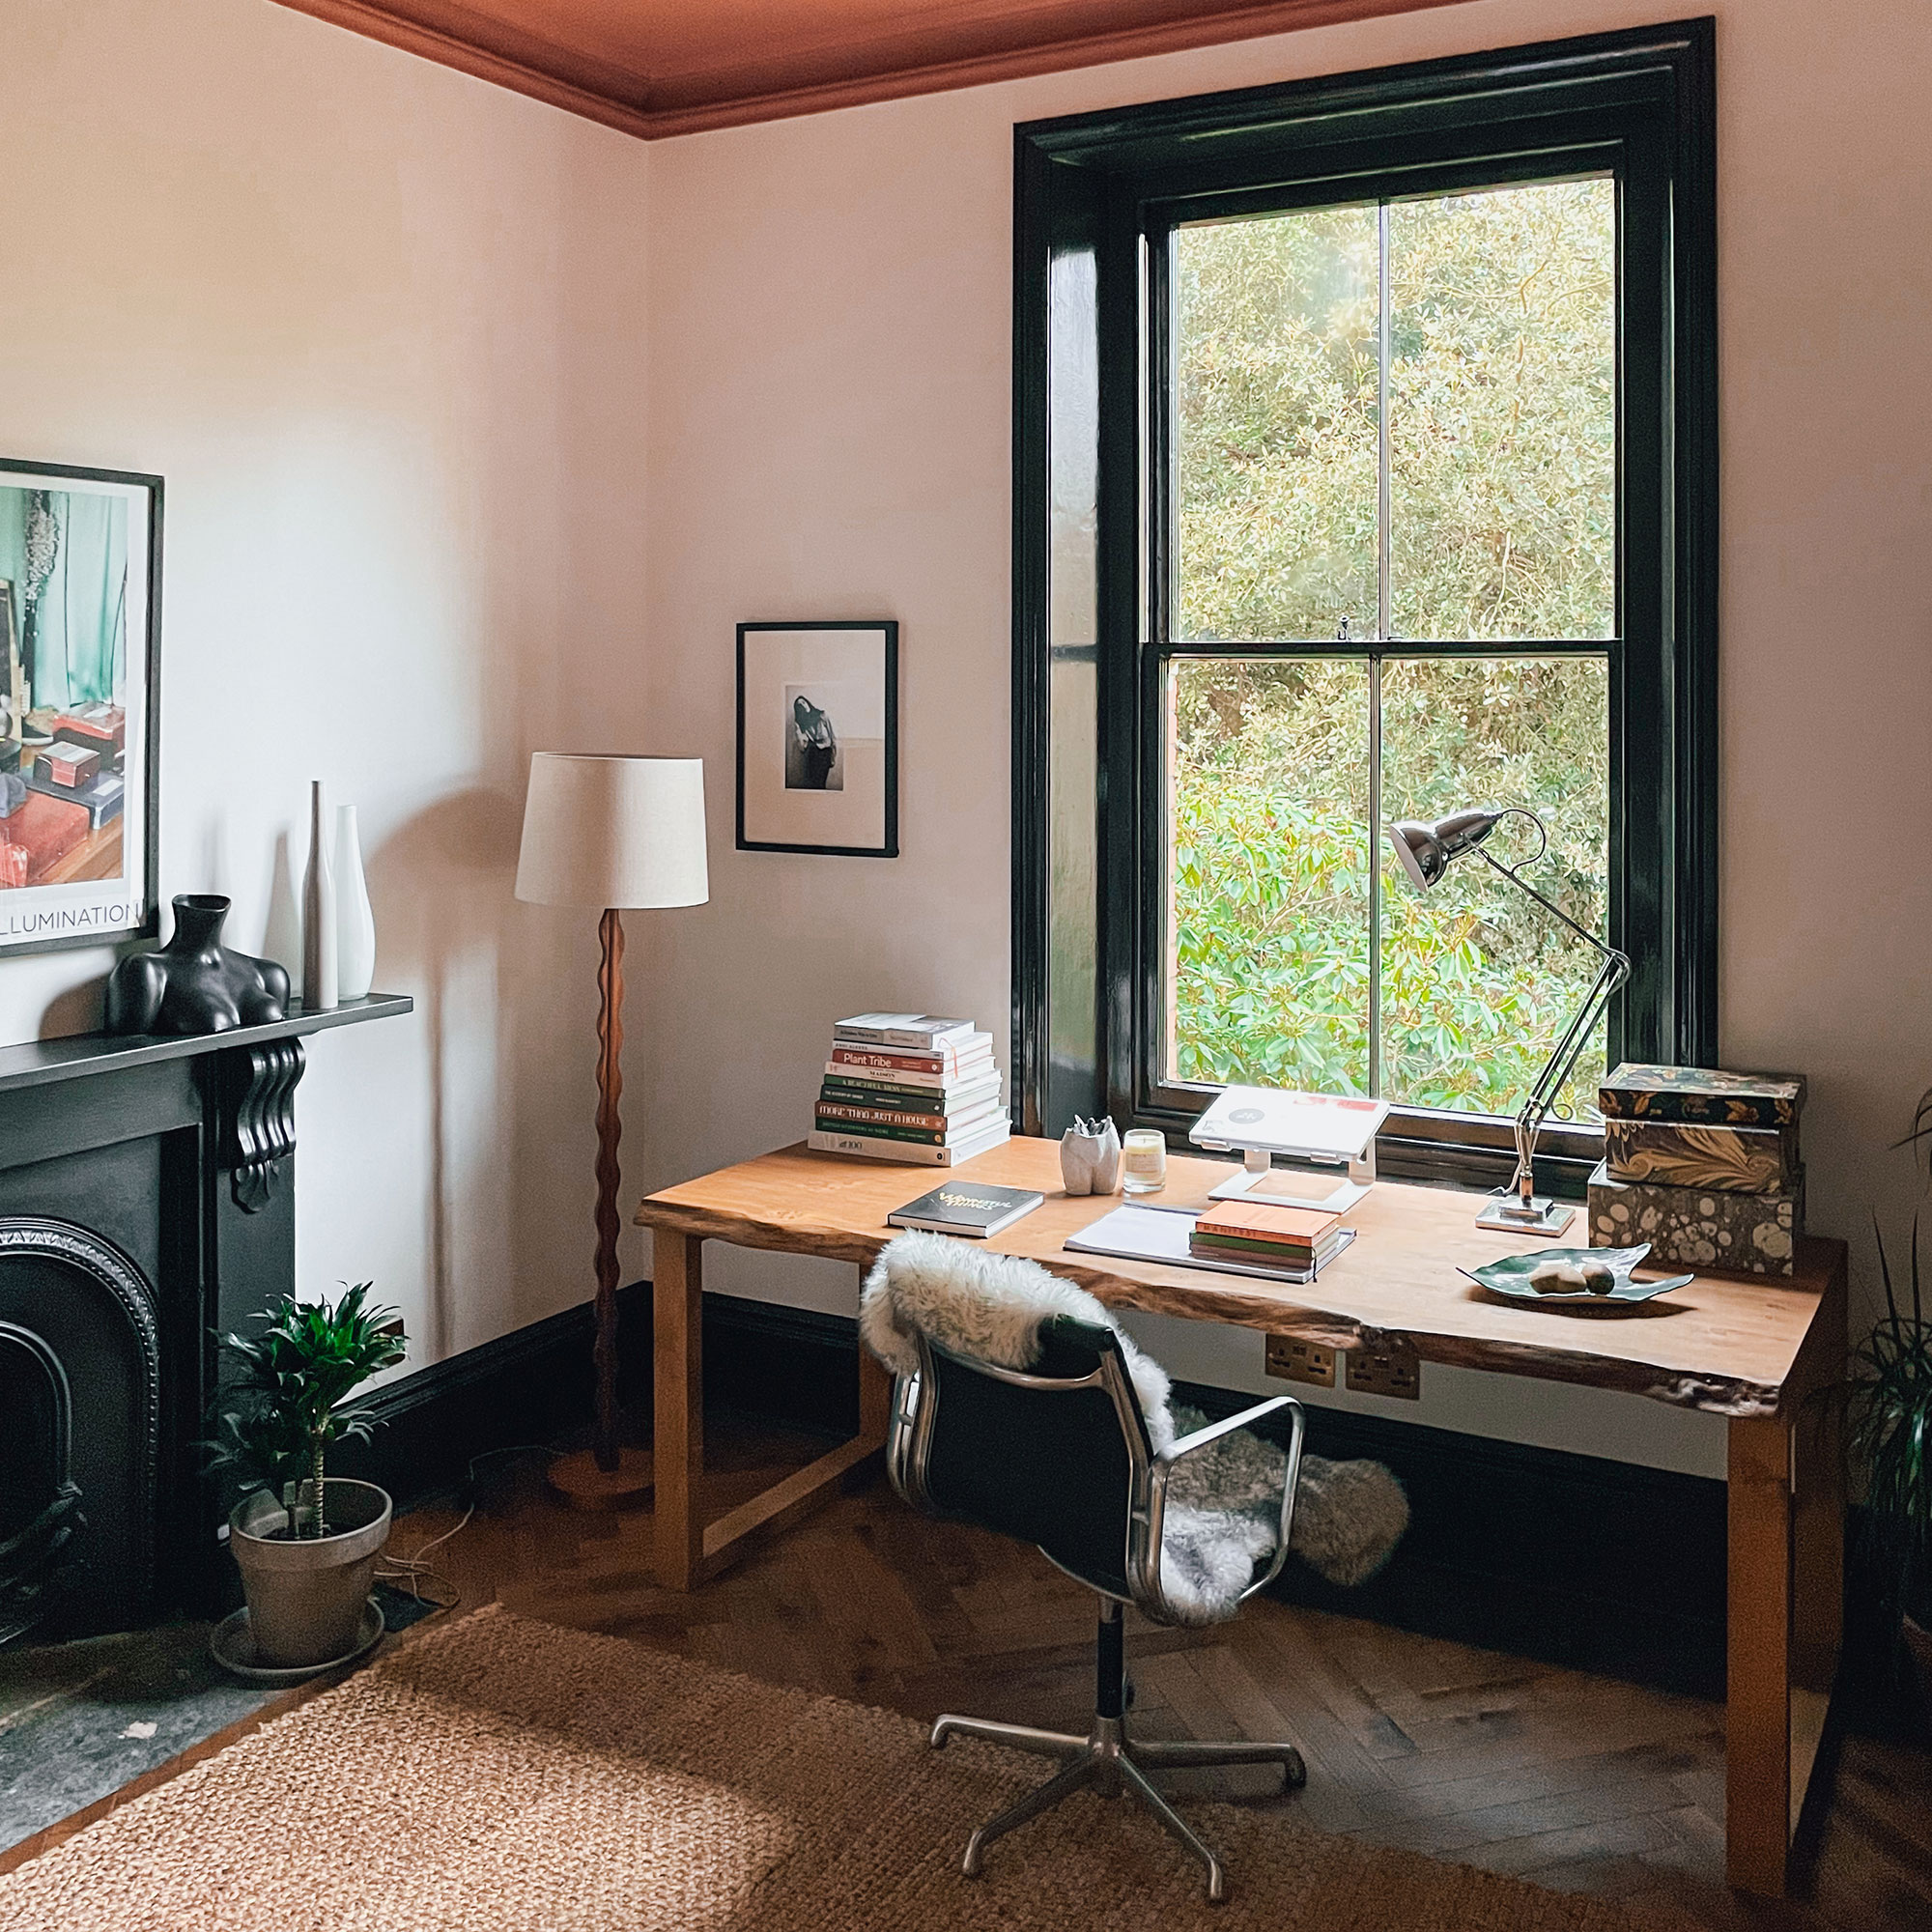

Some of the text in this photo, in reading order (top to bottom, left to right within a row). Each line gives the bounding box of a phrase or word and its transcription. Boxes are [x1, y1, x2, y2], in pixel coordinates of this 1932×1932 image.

[843, 1053, 867, 1065] Plant
[868, 1055, 892, 1067] Tribe
[819, 1105, 928, 1126] MORE THAN JUST A HOUSE
